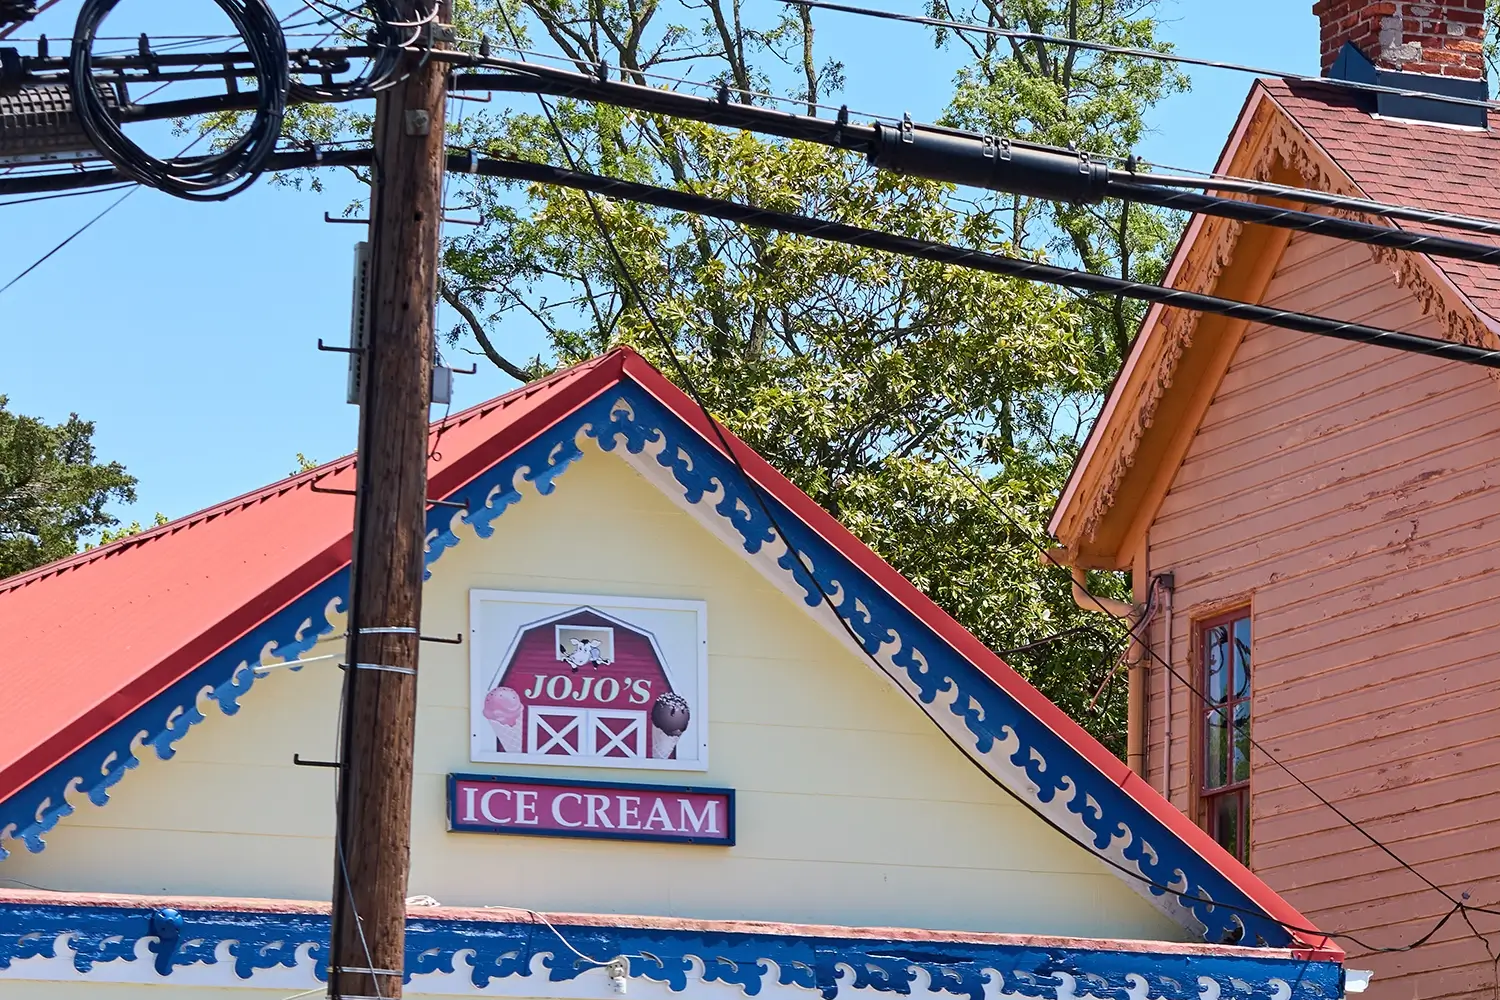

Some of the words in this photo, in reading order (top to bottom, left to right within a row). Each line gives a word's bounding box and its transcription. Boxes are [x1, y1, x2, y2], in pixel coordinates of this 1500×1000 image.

[524, 674, 652, 704] JOJO'S
[462, 788, 539, 825] ICE
[552, 792, 720, 834] CREAM
